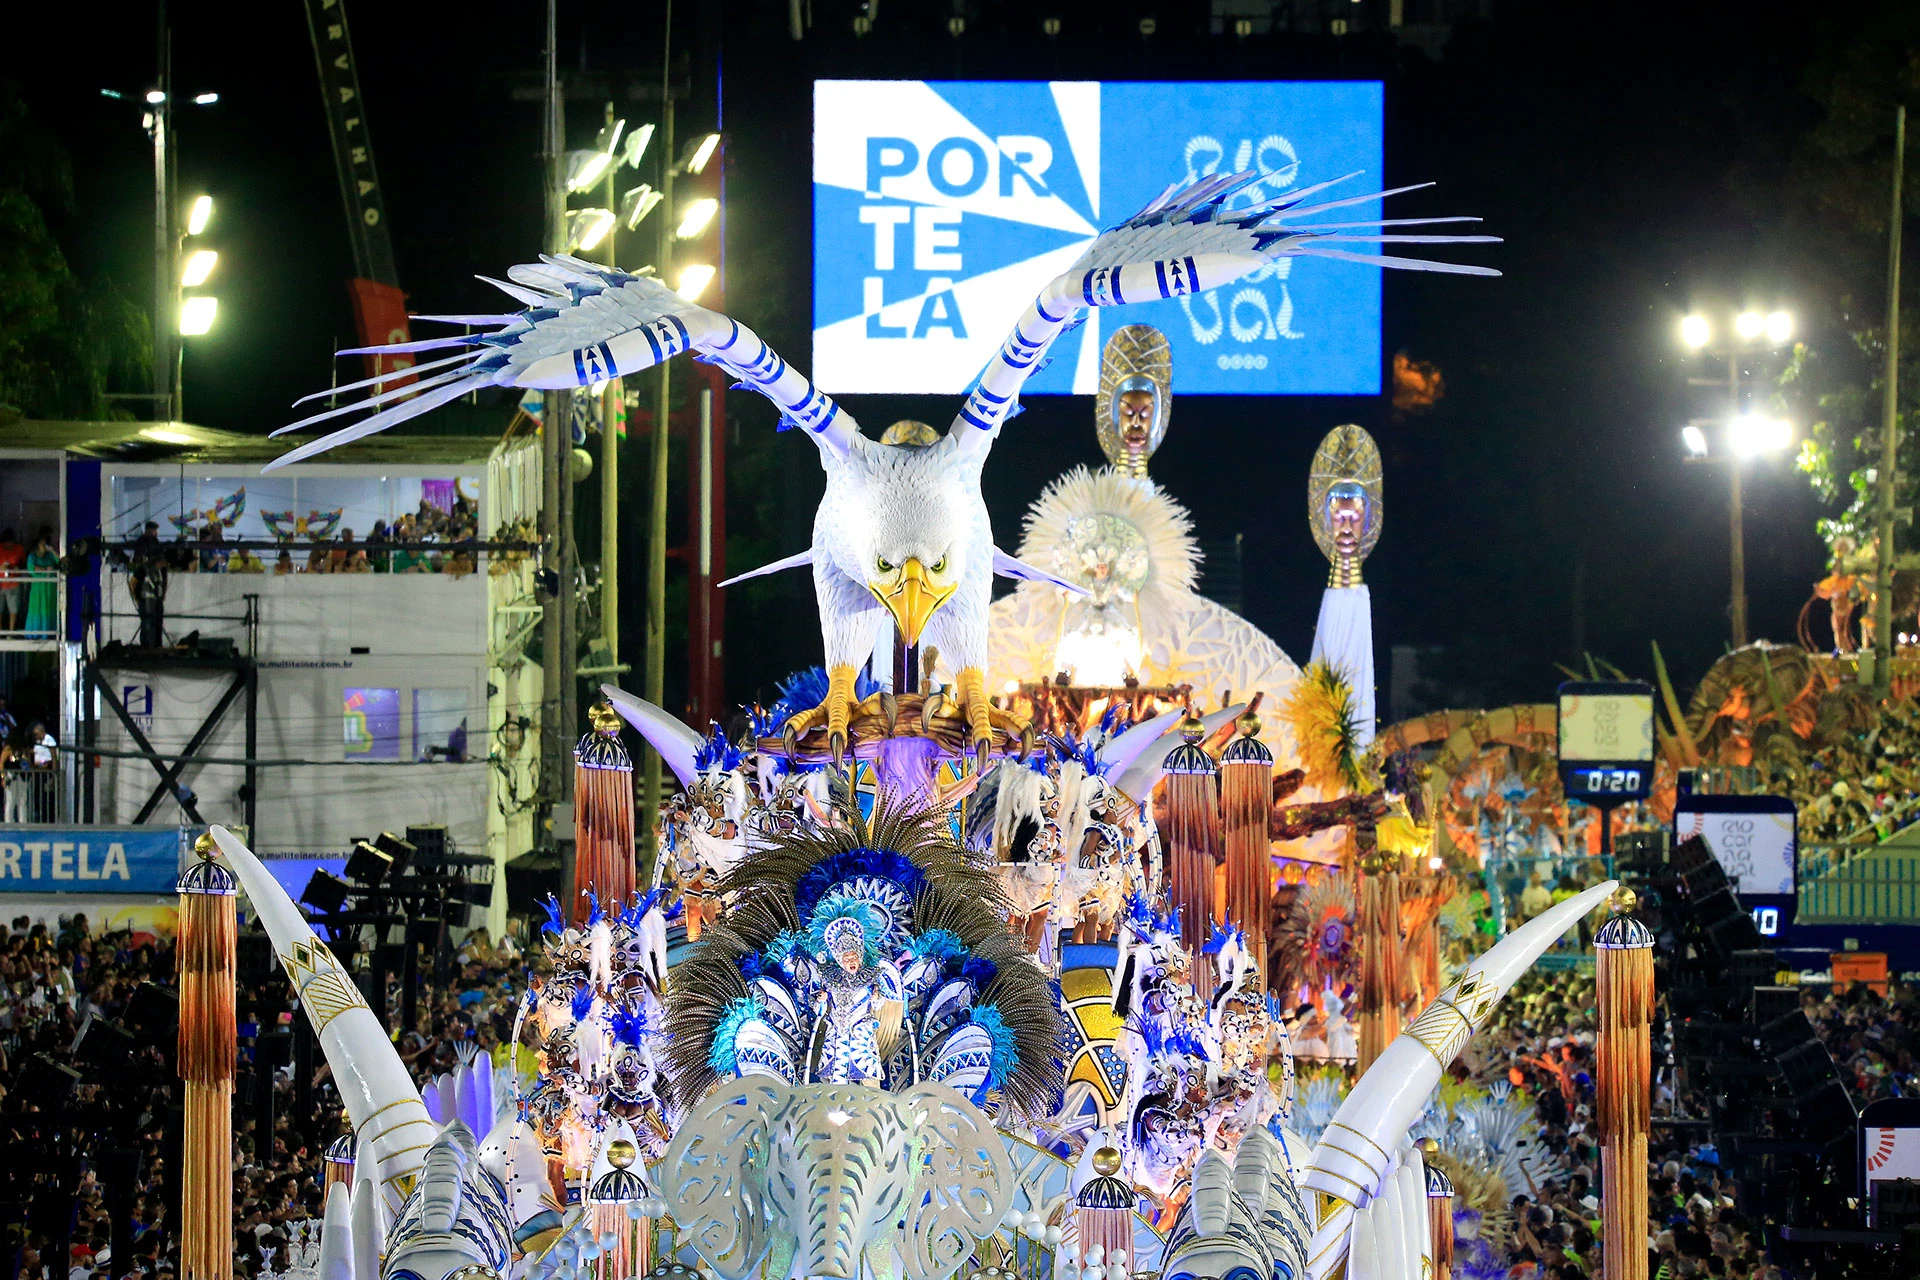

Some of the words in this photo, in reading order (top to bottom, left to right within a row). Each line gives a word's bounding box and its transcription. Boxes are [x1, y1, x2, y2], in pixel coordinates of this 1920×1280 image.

[865, 135, 1053, 198] POR
[859, 206, 963, 270] TE
[864, 277, 969, 339] LA
[1587, 770, 1641, 792] 0:20
[0, 842, 131, 880] RTELA
